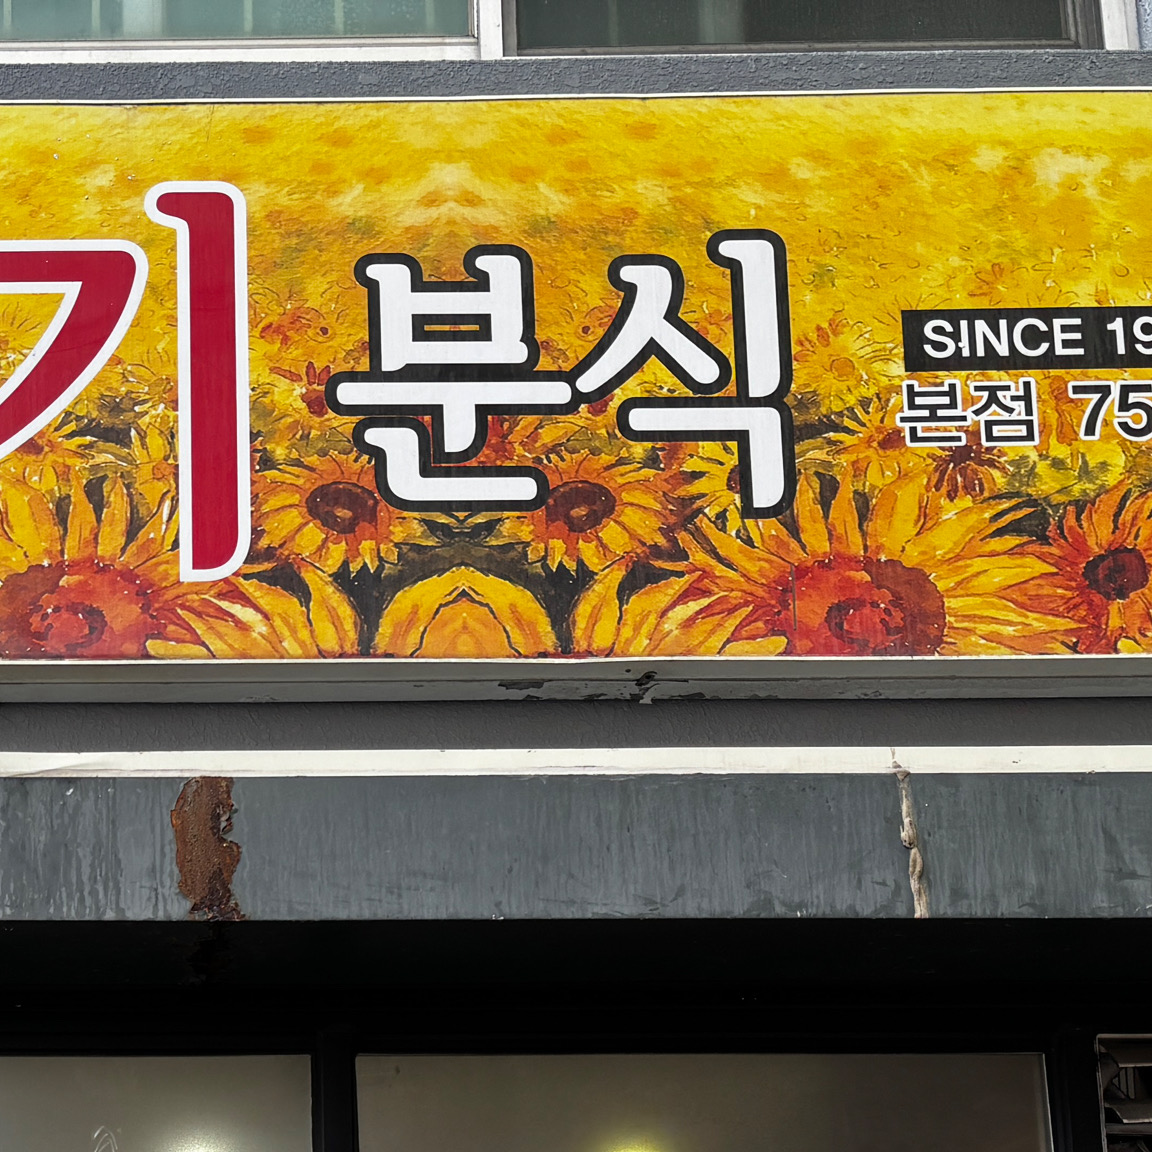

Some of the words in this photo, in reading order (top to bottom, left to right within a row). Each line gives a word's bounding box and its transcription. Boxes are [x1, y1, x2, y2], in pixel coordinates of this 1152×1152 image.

[923, 317, 1086, 359] SINCE
[326, 228, 796, 520] 분식
[898, 378, 1039, 446] 본점
